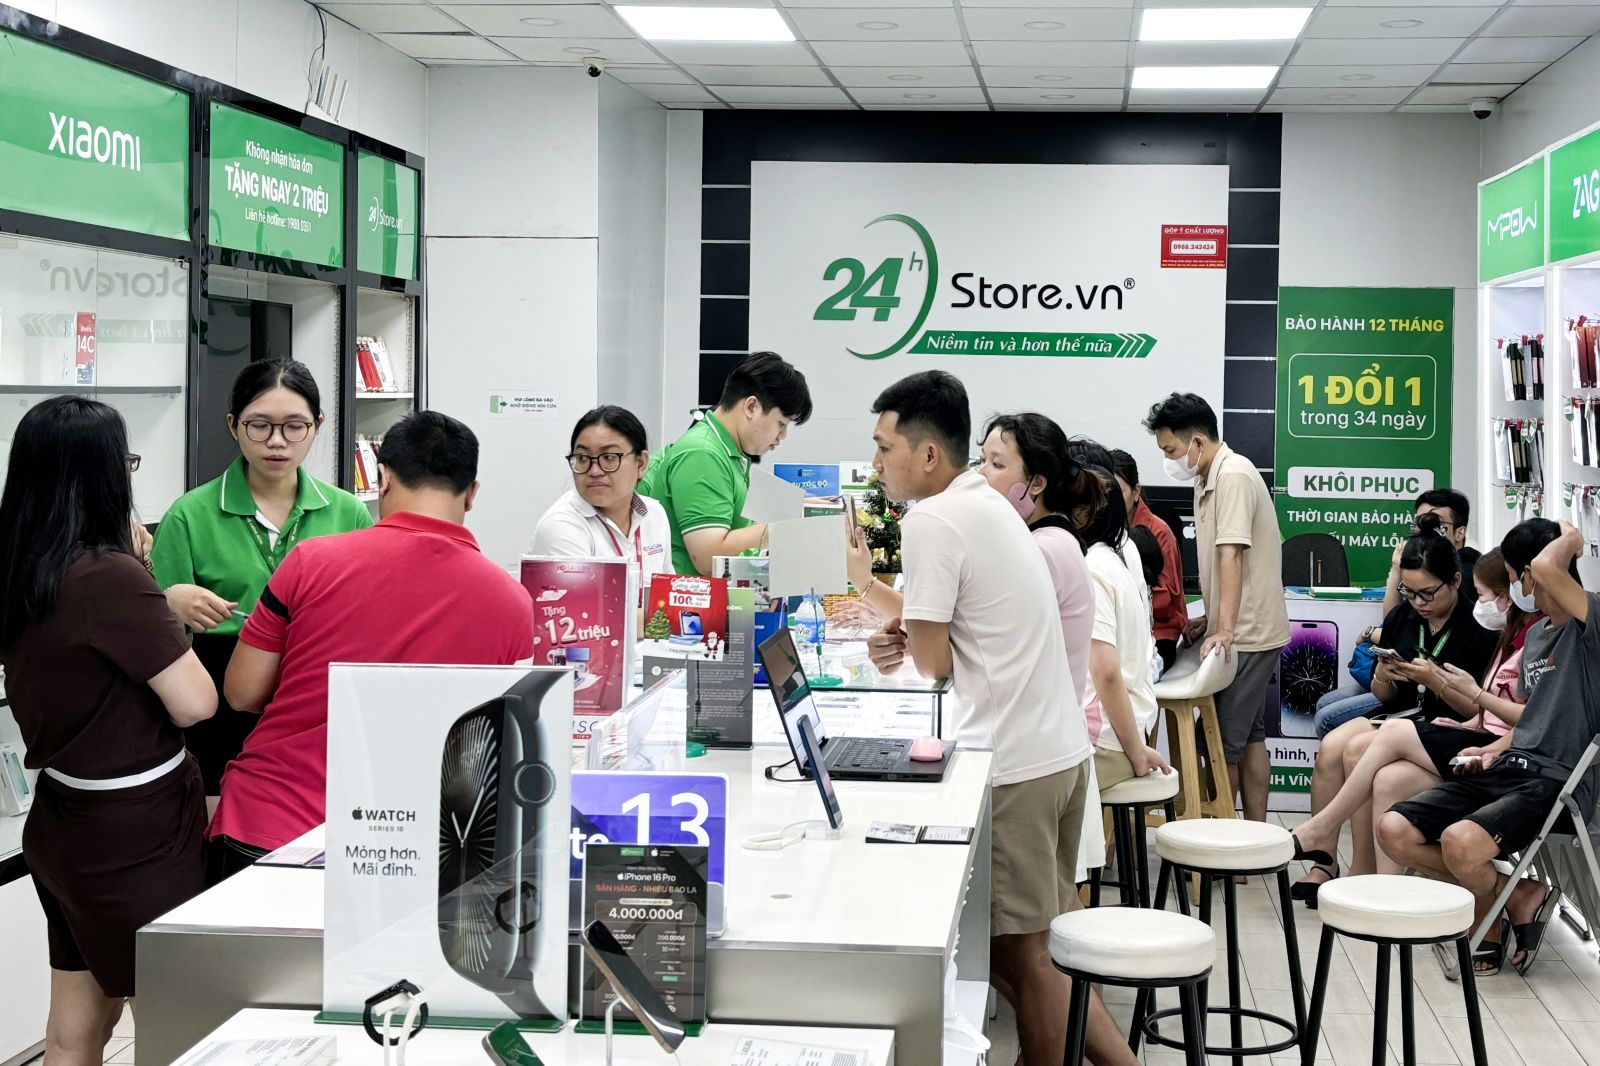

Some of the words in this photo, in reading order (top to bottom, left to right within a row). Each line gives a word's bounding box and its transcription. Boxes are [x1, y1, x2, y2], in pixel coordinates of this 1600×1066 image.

[245, 140, 270, 165] Không
[271, 148, 288, 168] nhận
[288, 154, 301, 171] hóa
[302, 157, 313, 174] đơn
[225, 161, 259, 198] TẶNG
[261, 175, 292, 205] NGAY
[292, 183, 300, 207] 2
[301, 184, 329, 218] TRIỆU
[1487, 200, 1537, 246] MPOW
[1285, 314, 1316, 330] BẢO
[1320, 315, 1365, 331] HÀNH
[1369, 318, 1386, 332] 12
[1389, 316, 1444, 332] THÁNG
[926, 334, 966, 351] Niềm
[973, 336, 994, 351] tin
[1000, 337, 1016, 352] và
[1021, 338, 1050, 352] hơn
[1055, 335, 1083, 352] thế
[1085, 338, 1113, 353] nữa
[1298, 375, 1314, 404] 1
[1324, 363, 1394, 406] ĐỔI
[1405, 377, 1421, 406] 1
[1300, 410, 1349, 429] trong
[1354, 411, 1377, 426] 34
[1382, 410, 1427, 430] ngày
[1304, 471, 1355, 492] KHÔI
[1361, 476, 1419, 497] PHỤC
[1287, 508, 1321, 522] THỜI
[1324, 512, 1358, 524] GIAN
[1361, 509, 1390, 524] BẢO
[1394, 510, 1417, 525] HÀ
[1349, 533, 1379, 547] MÁY
[541, 606, 566, 617] Tặng
[545, 617, 577, 645] 12
[577, 626, 610, 641] triệu
[1275, 747, 1310, 762] hình,
[365, 810, 416, 821] WATCH
[622, 792, 710, 846] 13
[345, 845, 386, 862] Mỏng
[391, 846, 420, 860] hơn.
[353, 862, 378, 875] Mãi
[382, 863, 417, 876] đỉnh.
[624, 873, 651, 881] iPhone
[663, 874, 676, 882] Pro
